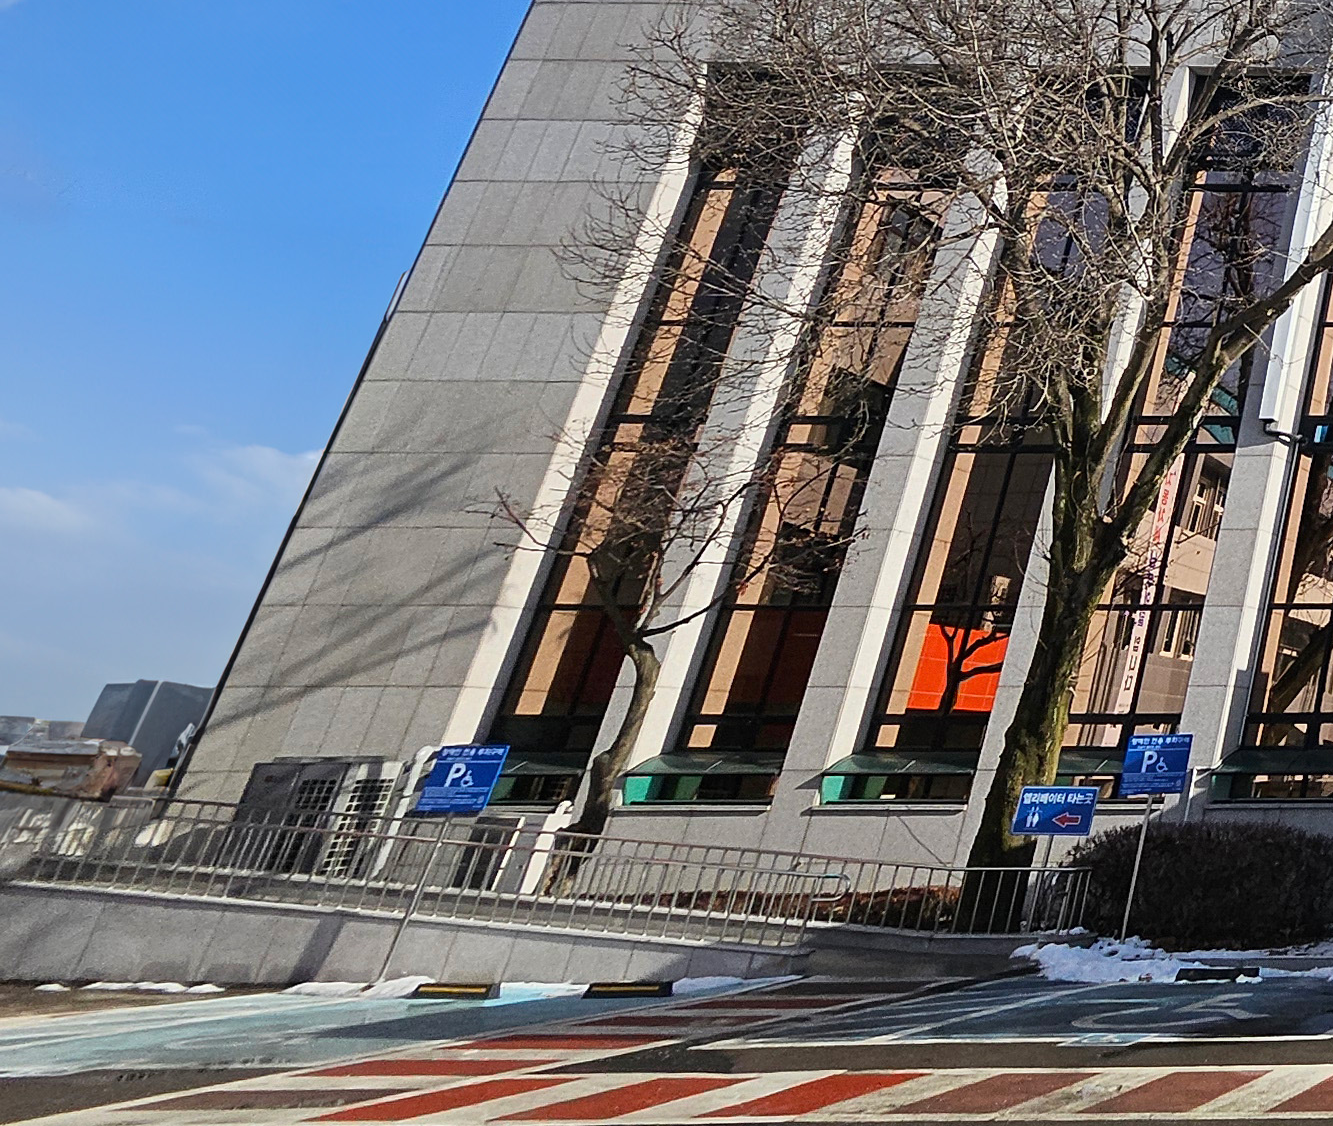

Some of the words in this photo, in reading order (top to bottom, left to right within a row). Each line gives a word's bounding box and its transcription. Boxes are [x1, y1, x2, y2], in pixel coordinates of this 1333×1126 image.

[1141, 750, 1158, 773] P
[444, 763, 467, 787] P
[1067, 792, 1094, 804] 타는곳
